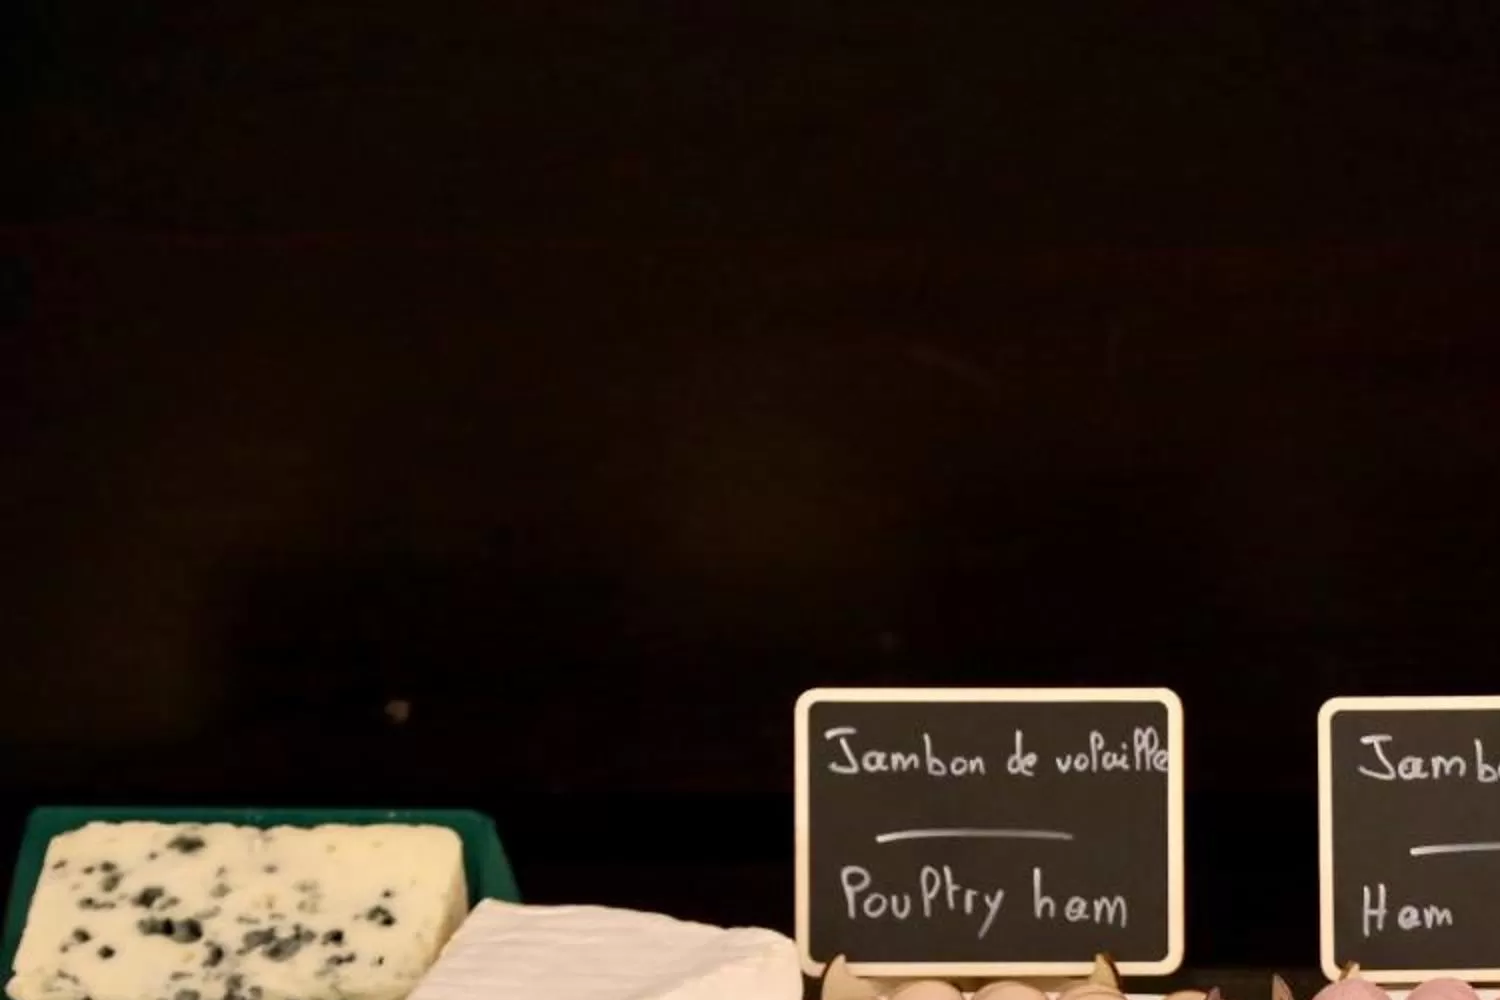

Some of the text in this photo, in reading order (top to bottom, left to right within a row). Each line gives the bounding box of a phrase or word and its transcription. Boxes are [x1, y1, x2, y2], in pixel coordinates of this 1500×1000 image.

[823, 725, 1168, 777] Jambon de volaille
[840, 864, 1127, 939] Poultry ham
[1362, 882, 1453, 938] Ham
